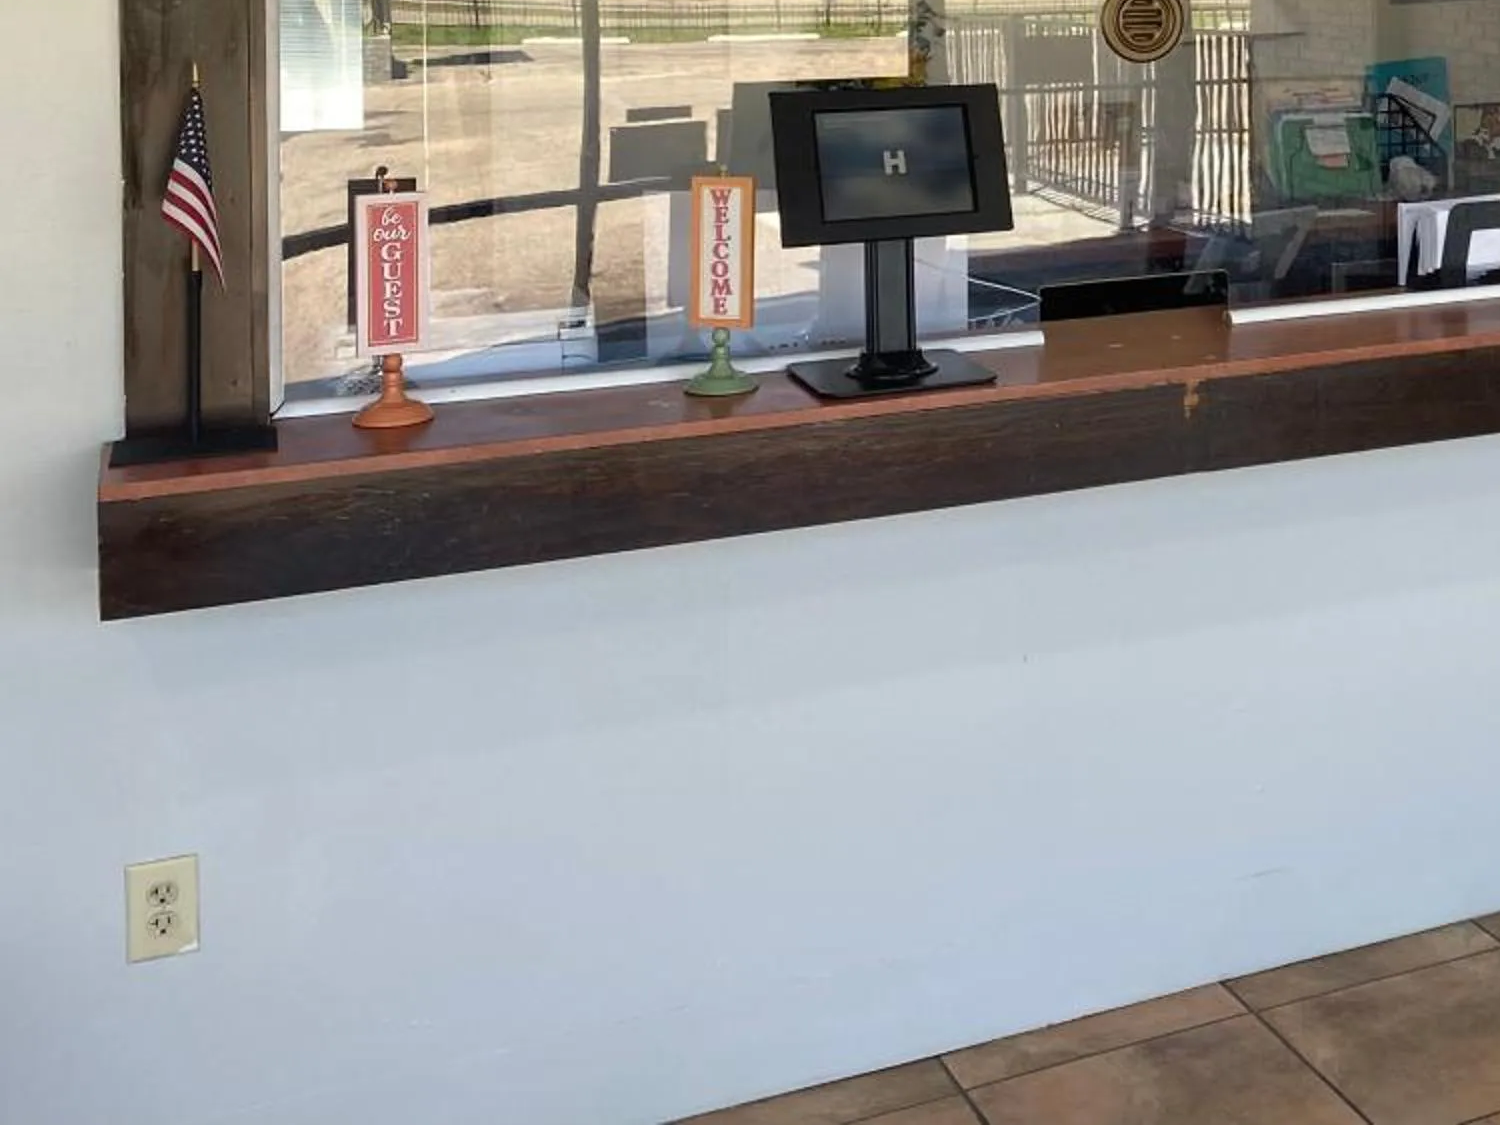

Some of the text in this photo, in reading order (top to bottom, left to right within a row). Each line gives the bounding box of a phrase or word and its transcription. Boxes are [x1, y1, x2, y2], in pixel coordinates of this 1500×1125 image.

[883, 149, 907, 175] H
[381, 207, 402, 226] be
[373, 225, 411, 242] our
[710, 188, 733, 315] WELCOME
[380, 242, 403, 337] GUEST
